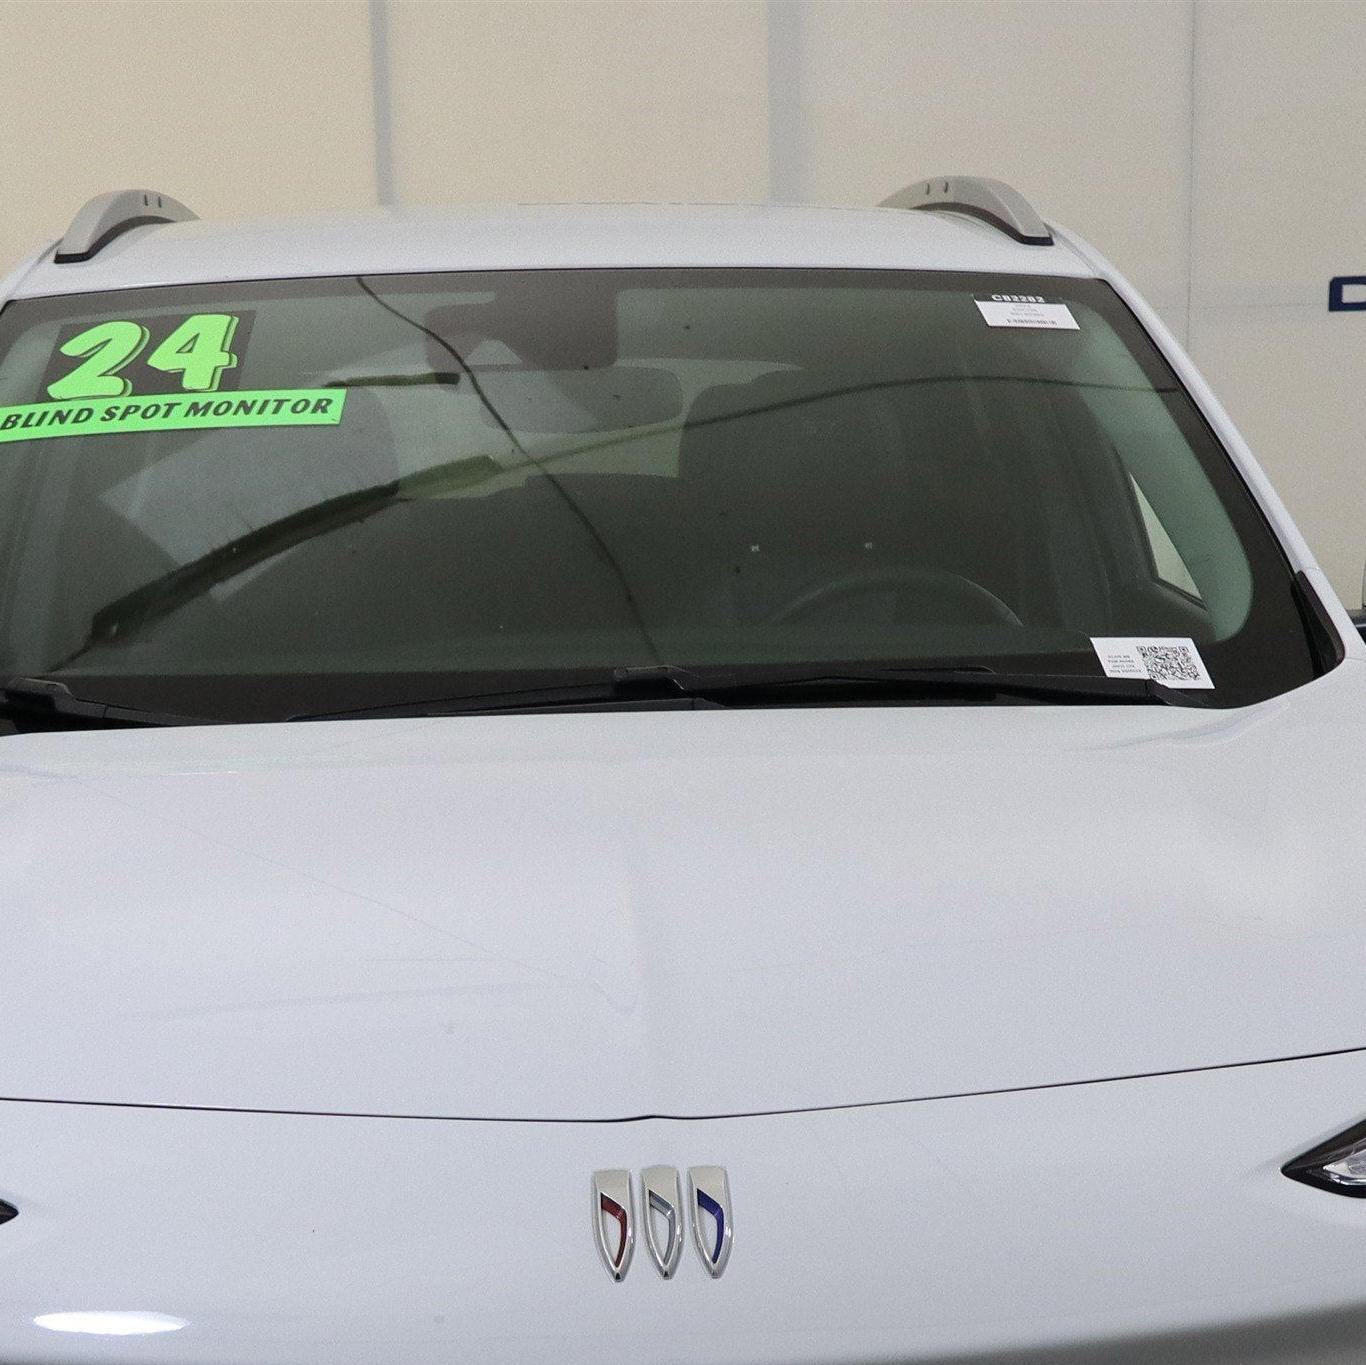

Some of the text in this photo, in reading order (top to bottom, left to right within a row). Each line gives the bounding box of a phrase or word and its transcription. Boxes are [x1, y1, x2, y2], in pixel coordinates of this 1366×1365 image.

[46, 313, 239, 400] 24
[101, 401, 182, 422] SPOT
[183, 397, 334, 418] MONITOR
